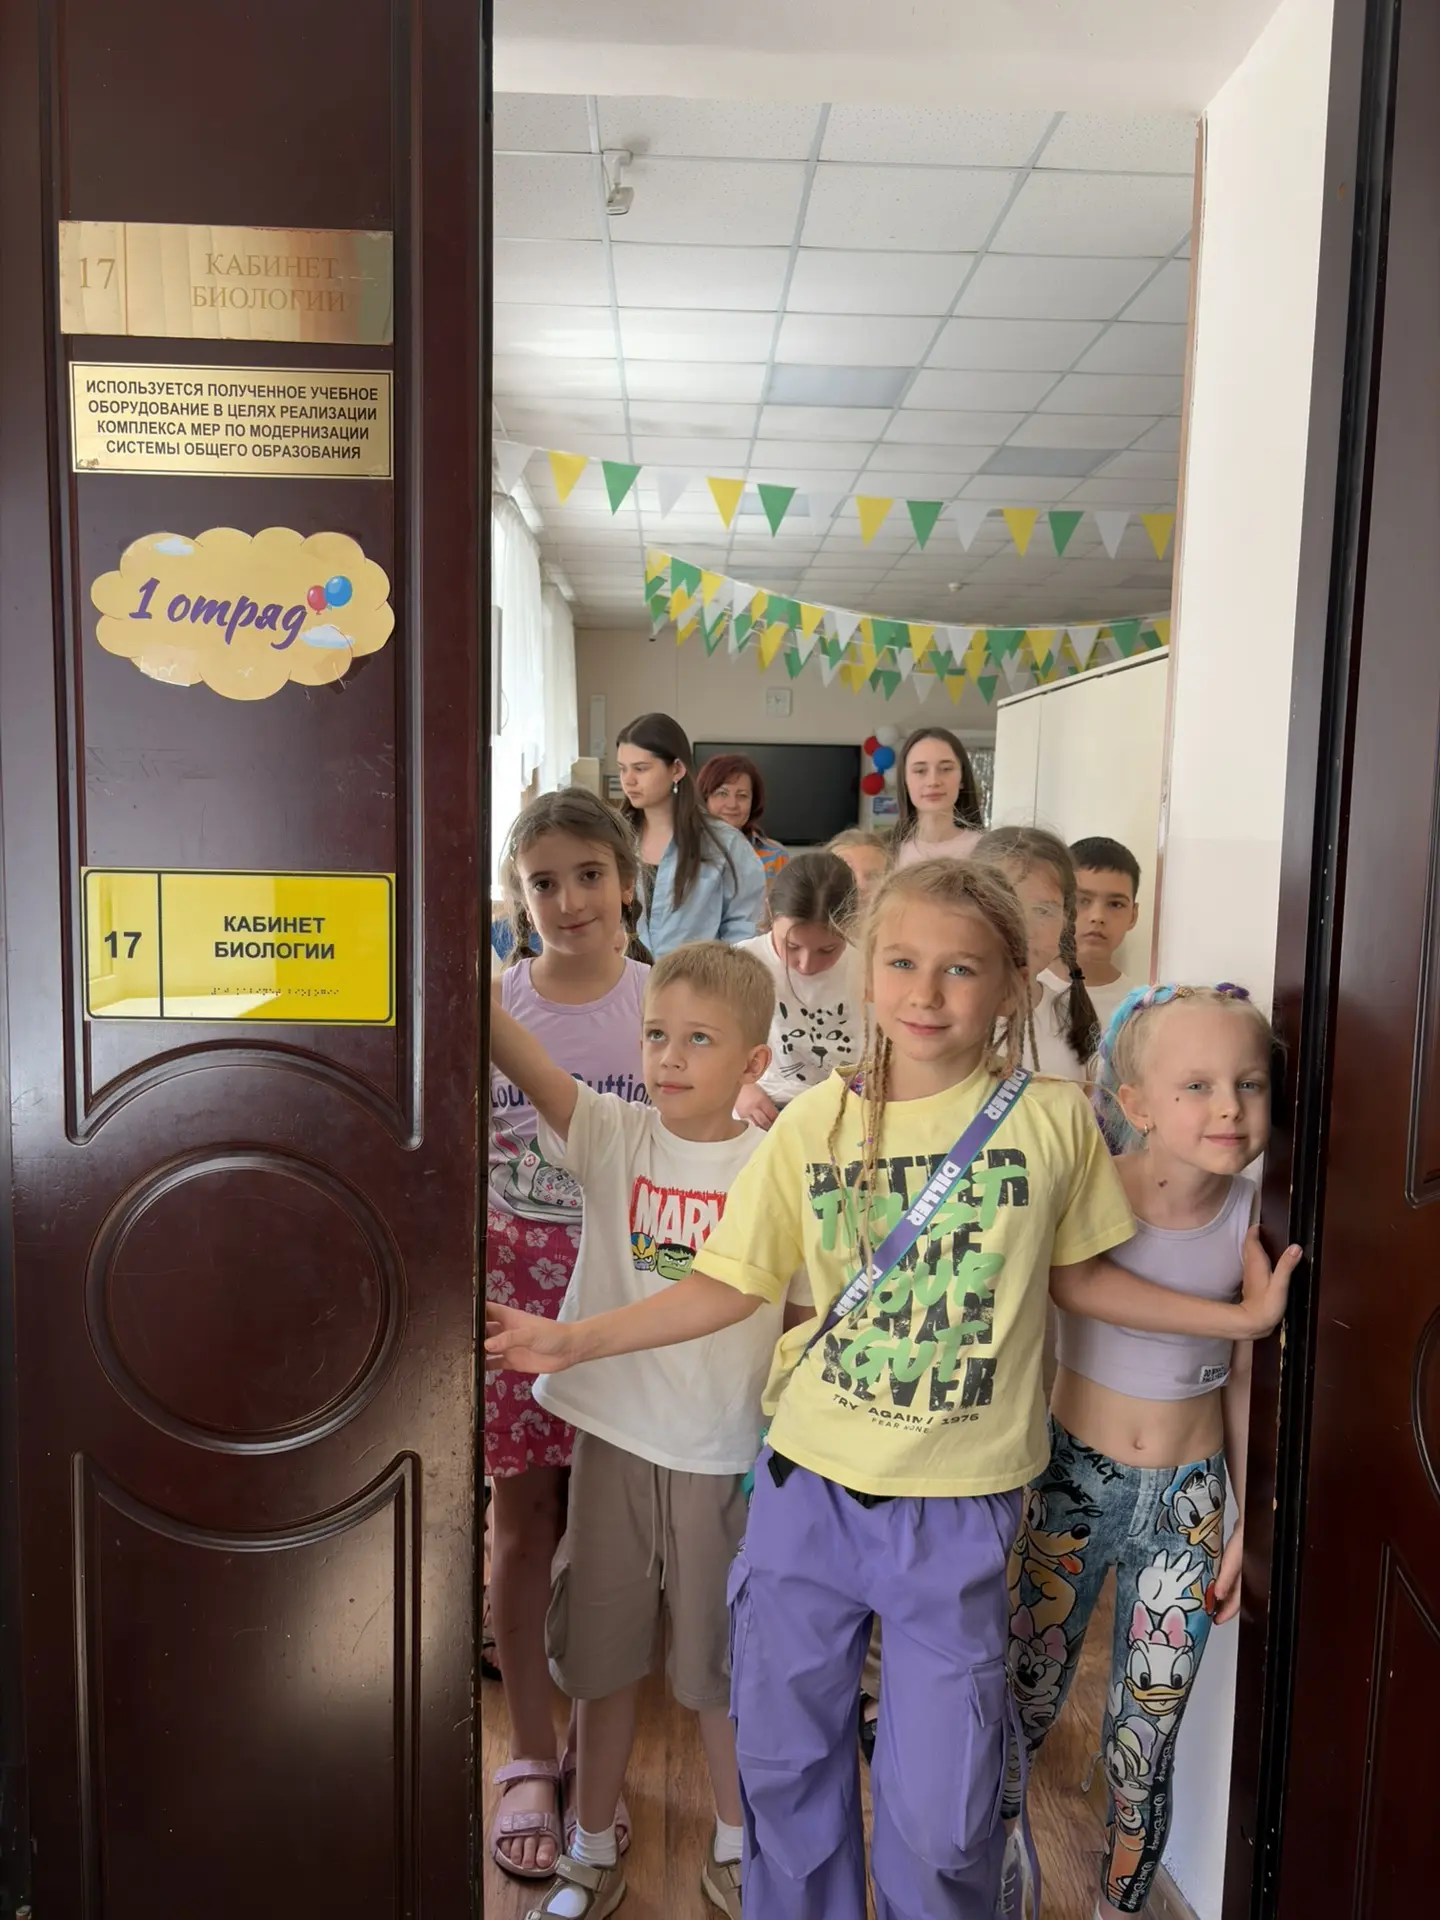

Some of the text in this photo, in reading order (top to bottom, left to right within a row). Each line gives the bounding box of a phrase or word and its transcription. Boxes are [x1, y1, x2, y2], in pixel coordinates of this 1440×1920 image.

[78, 257, 116, 290] 17
[205, 253, 338, 280] КАБИНЕТ
[191, 286, 346, 313] БИОЛОГИИ
[86, 379, 379, 401] ИСПОЛЬЗУЕТСЯ ПОЛУЧЕННОЕ УЧЕБНОЕ
[88, 400, 377, 421] ОБОРУДОВАНИЕ В ЦЕЛЯХ РЕАЛИЗАЦИИ
[97, 420, 370, 440] КОМПЛЕКСА МЕР ПО МОДЕРНИЗАЦИИ
[106, 440, 361, 459] СИСТЕМЫ ОБЩЕГО ОБРАЗОВАНИЯ
[128, 577, 160, 619] 1
[223, 915, 326, 934] КАБИНЕТ
[104, 930, 142, 959] 17
[214, 942, 335, 960] БИОЛОГИИ
[489, 1084, 532, 1108] Lou
[905, 1160, 961, 1226] DILLER
[833, 1394, 860, 1411] TRY
[868, 1407, 923, 1424] AGAIN
